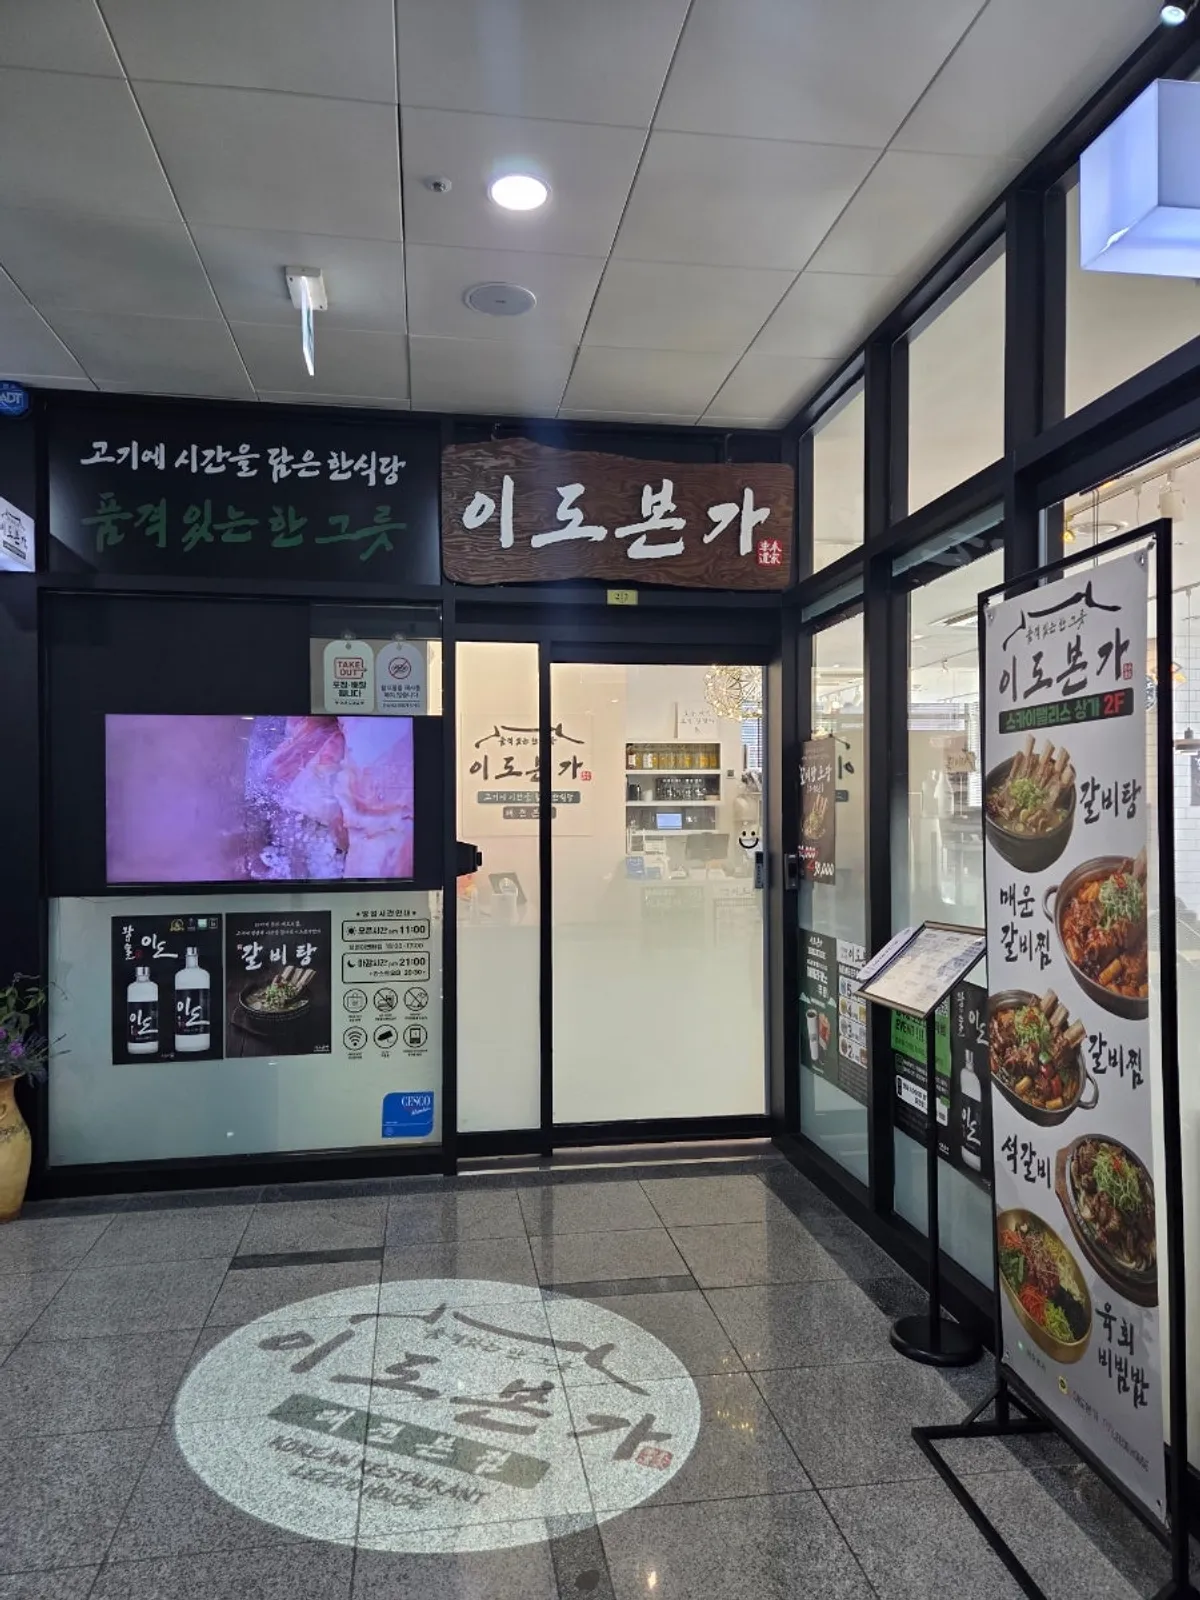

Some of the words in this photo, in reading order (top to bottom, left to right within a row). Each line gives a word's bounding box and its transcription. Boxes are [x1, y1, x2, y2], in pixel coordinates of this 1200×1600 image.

[80, 440, 166, 471] 고기에
[174, 444, 260, 478] 시간을
[268, 448, 322, 483] 담은
[328, 451, 407, 486] 한식당
[80, 492, 168, 553] 품격
[181, 499, 260, 552] 있는
[268, 506, 308, 549] 한
[315, 506, 408, 563] 그릇
[462, 475, 771, 559] 이도본가
[998, 627, 1131, 702] 이도본가
[1103, 691, 1126, 716] 2F
[1079, 776, 1142, 825] 갈비탕
[999, 883, 1036, 918] 매운
[141, 933, 179, 959] 이도
[399, 925, 426, 935] 11:00
[1001, 922, 1052, 970] 갈비찜
[241, 941, 318, 971] 갈비탕
[399, 957, 426, 967] 21:00
[129, 1009, 159, 1035] 이도
[177, 997, 211, 1027] 이도
[1088, 1032, 1144, 1089] 갈비찜
[401, 1094, 431, 1107] CESCO
[1001, 1135, 1051, 1190] 석갈비
[1095, 1302, 1135, 1356] 육회
[1098, 1347, 1150, 1410] 비빔밥
[268, 1434, 356, 1468] KOREAN
[361, 1459, 492, 1505] RESTAURANT
